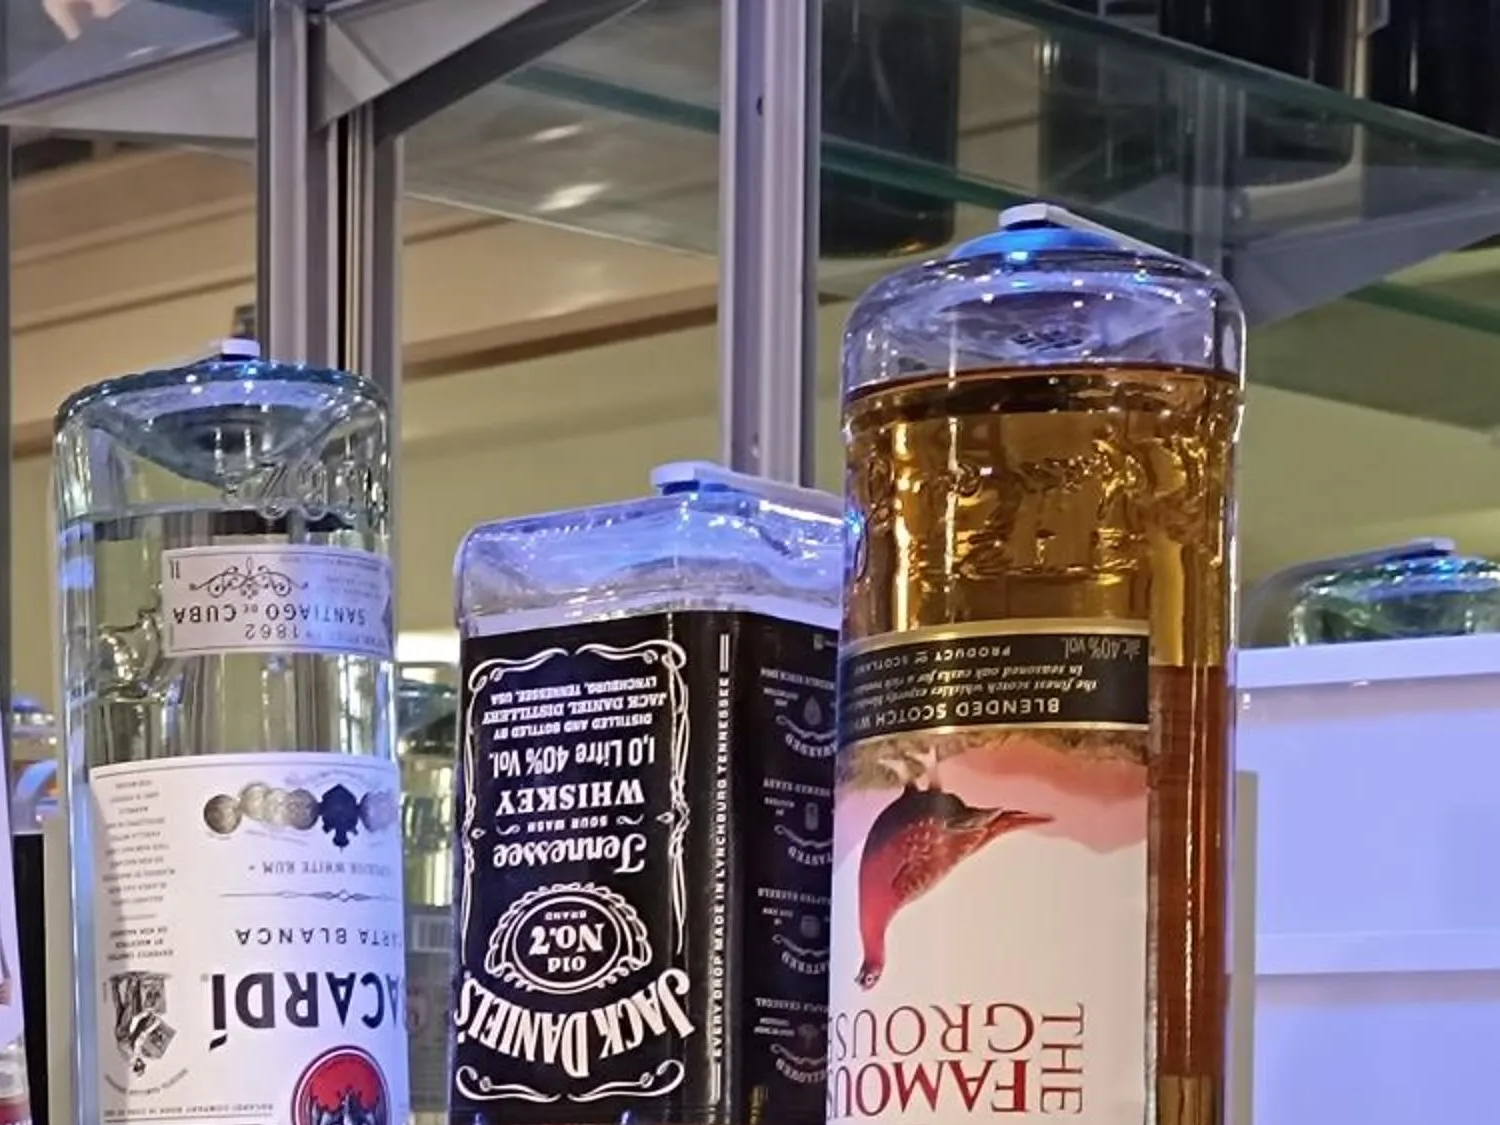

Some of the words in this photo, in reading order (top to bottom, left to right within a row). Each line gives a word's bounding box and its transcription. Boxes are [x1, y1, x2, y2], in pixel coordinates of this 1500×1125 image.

[173, 603, 237, 625] CUBA
[266, 603, 367, 625] SANTIAGO
[244, 624, 299, 641] 1862
[935, 645, 1012, 661] PRODUCT
[567, 696, 625, 716] DANIEL
[626, 692, 668, 709] JACK
[955, 698, 1061, 718] BLENDED
[480, 703, 565, 725] DISTILLERY
[591, 712, 654, 730] DISTILLED
[874, 703, 948, 729] SCOTCH
[493, 727, 509, 741] BY
[510, 720, 561, 738] BOTTLED
[563, 719, 589, 734] AND
[488, 749, 522, 779] Vol.
[525, 745, 570, 776] 40%
[575, 738, 622, 770] Litre
[495, 779, 646, 817] WHISKEY
[526, 817, 565, 833] MASH
[569, 814, 608, 830] SOUR
[492, 832, 648, 874] Tennessee
[544, 909, 587, 921] BRAND
[234, 927, 347, 946] BLANCA
[357, 928, 402, 948] ARTA
[546, 955, 587, 973] Old
[208, 971, 400, 1053] ACARDÍ
[590, 967, 696, 1060] JACK
[453, 970, 590, 1079] DANIEL'S
[1040, 1001, 1086, 1116] THE
